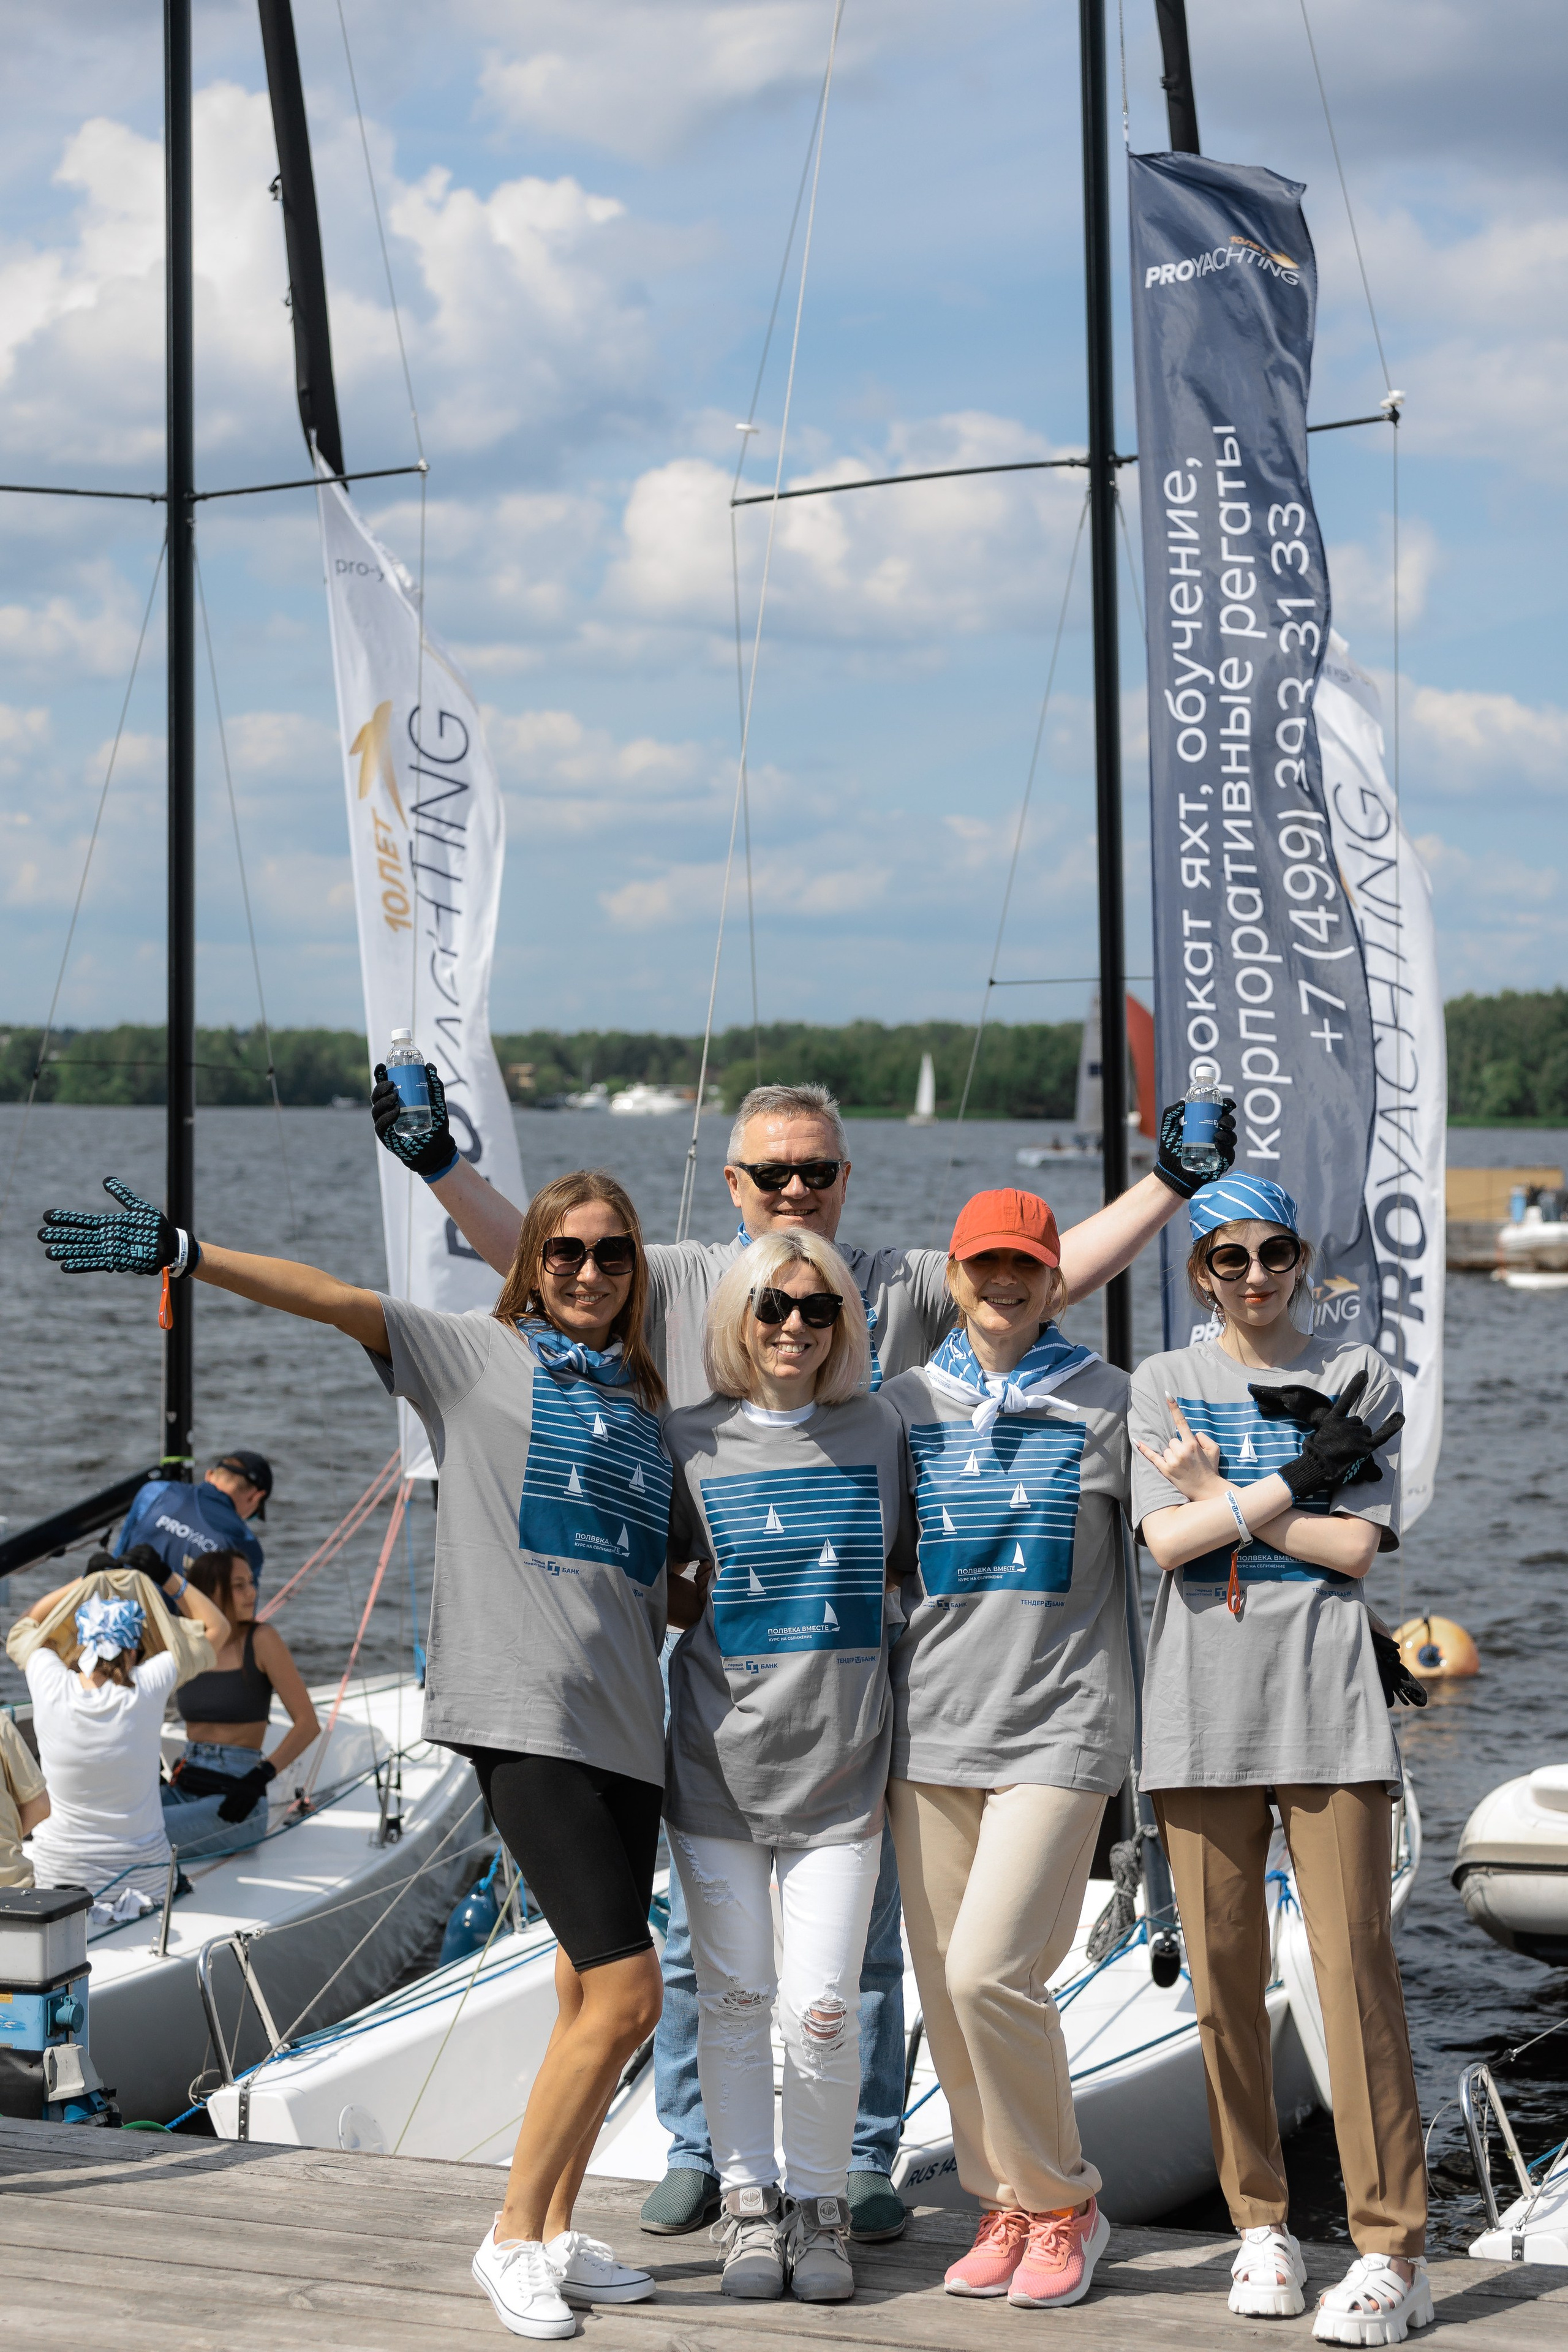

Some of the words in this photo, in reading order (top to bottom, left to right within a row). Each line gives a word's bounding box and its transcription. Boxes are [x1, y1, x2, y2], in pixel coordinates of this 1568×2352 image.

[1144, 246, 1300, 288] PROYACHTING
[1212, 425, 1267, 639] регаты
[1267, 501, 1310, 576] 33
[1163, 457, 1216, 763] обучение,
[1276, 597, 1321, 657] 31
[1178, 784, 1215, 890] яхт,
[1219, 656, 1293, 1159] корпоративные
[1276, 809, 1356, 960] (499)
[1182, 910, 1235, 1093] рокат
[1297, 979, 1348, 1053] +7
[575, 1532, 609, 1545] ПОЛВЕКА
[905, 2163, 938, 2188] RUS
